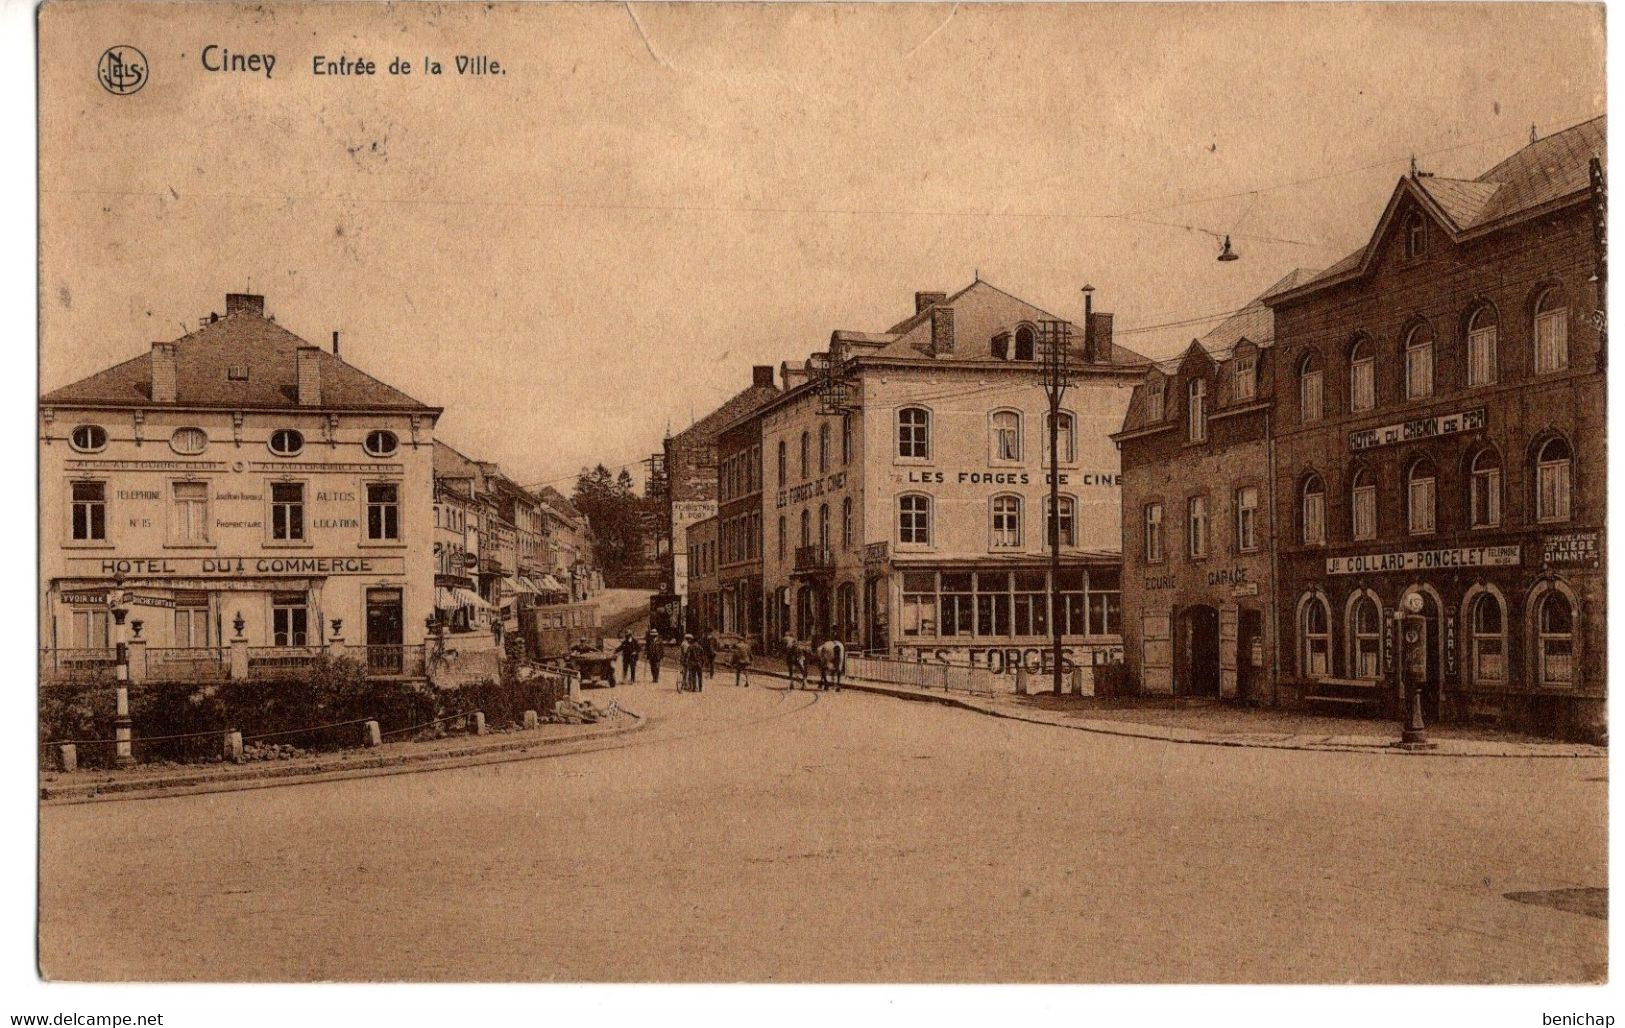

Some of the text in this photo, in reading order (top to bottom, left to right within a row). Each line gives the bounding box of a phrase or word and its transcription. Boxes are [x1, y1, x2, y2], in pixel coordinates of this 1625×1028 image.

[1350, 409, 1485, 449] HOTEL DU CHEMIN DE FER
[909, 470, 944, 483] LES
[958, 472, 1029, 485] FORGES
[1046, 473, 1069, 485] DE
[116, 490, 161, 500] TELEPHONE
[316, 491, 356, 501] AUTOS
[776, 491, 787, 509] LES
[790, 481, 813, 505] FORGES
[815, 477, 825, 497] DE
[313, 519, 359, 529] LOCATION
[101, 558, 373, 574] HOTEL DU COMMERCE
[1145, 575, 1177, 591] ECURIE
[1208, 568, 1248, 586] GARAGE
[63, 594, 88, 603] YVOIR
[1446, 617, 1455, 672] MARLY
[969, 648, 1076, 675] FORGES
